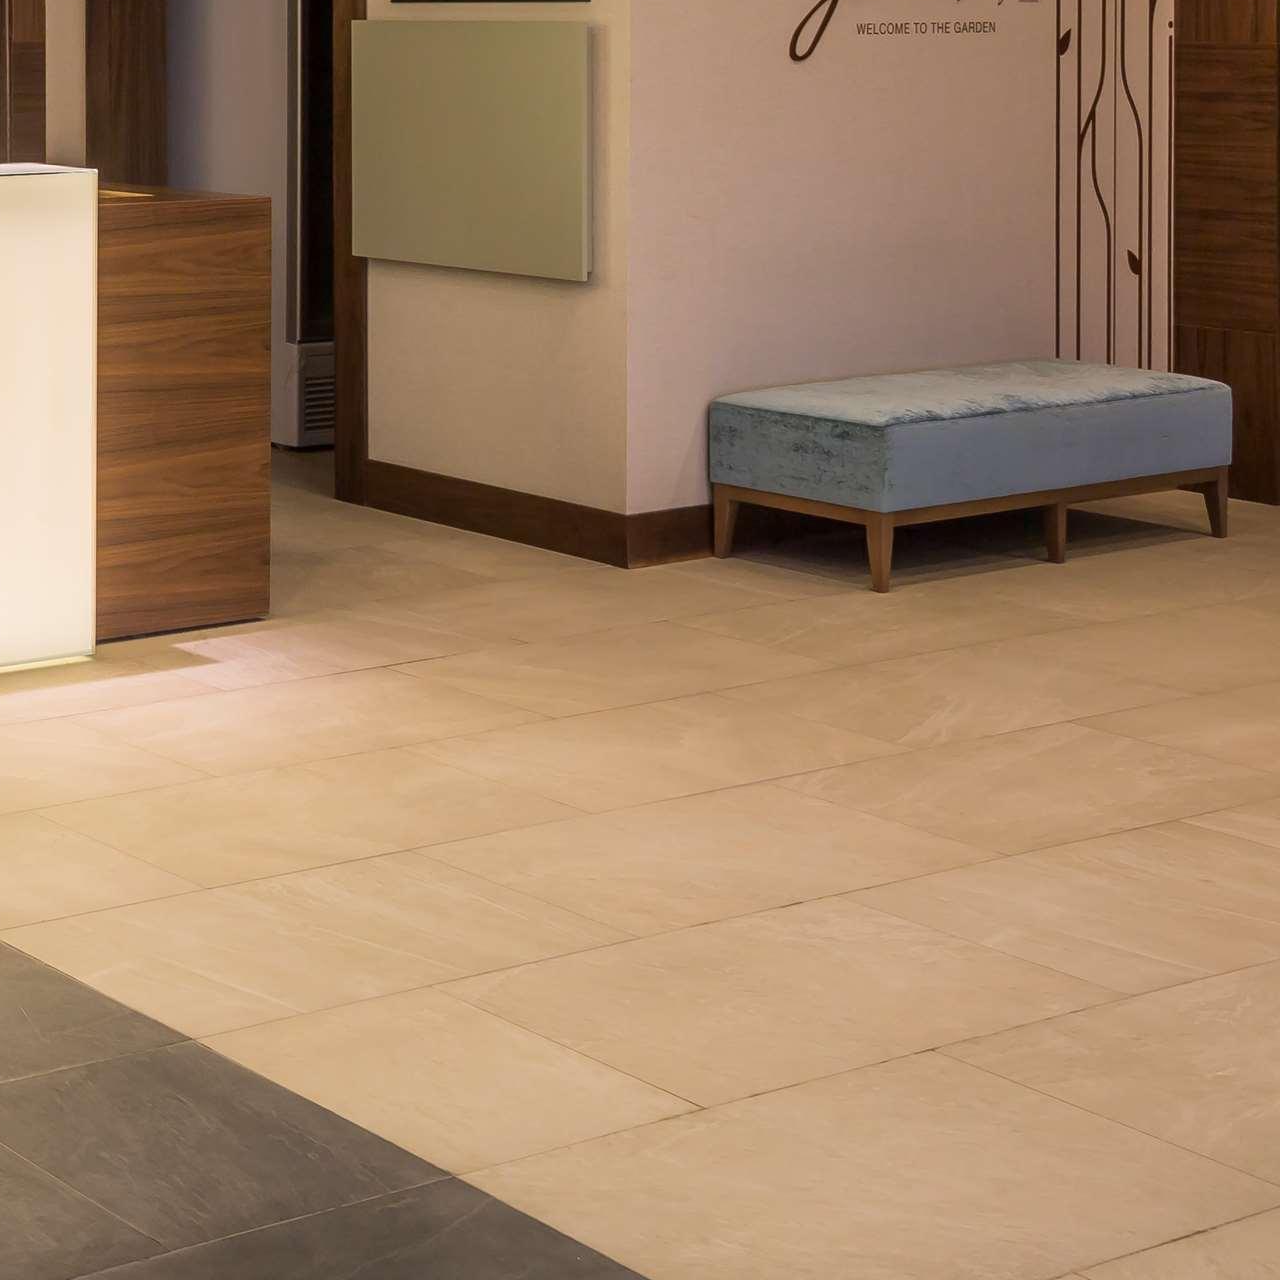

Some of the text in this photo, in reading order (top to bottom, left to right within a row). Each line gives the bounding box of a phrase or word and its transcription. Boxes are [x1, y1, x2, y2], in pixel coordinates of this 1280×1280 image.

[856, 21, 996, 36] WELCOME TO THE GARDEN
